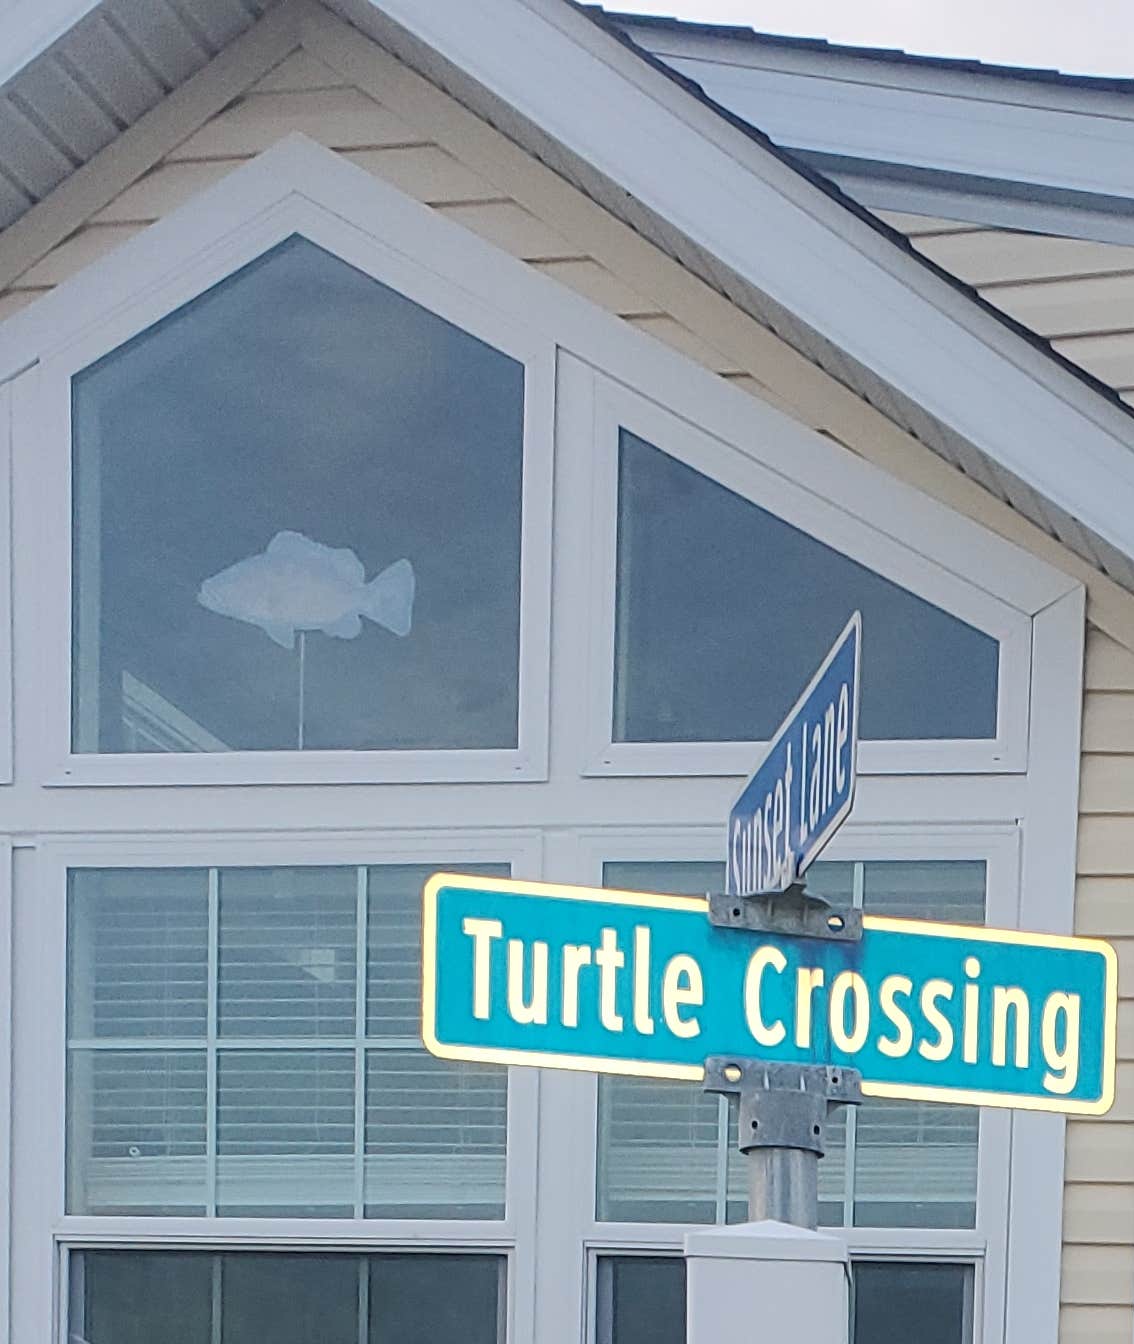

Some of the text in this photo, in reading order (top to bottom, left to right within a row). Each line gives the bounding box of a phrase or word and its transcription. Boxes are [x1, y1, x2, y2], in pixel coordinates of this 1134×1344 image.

[732, 682, 849, 895] Sunset Lane
[462, 916, 1082, 1093] Turtle Crossing
